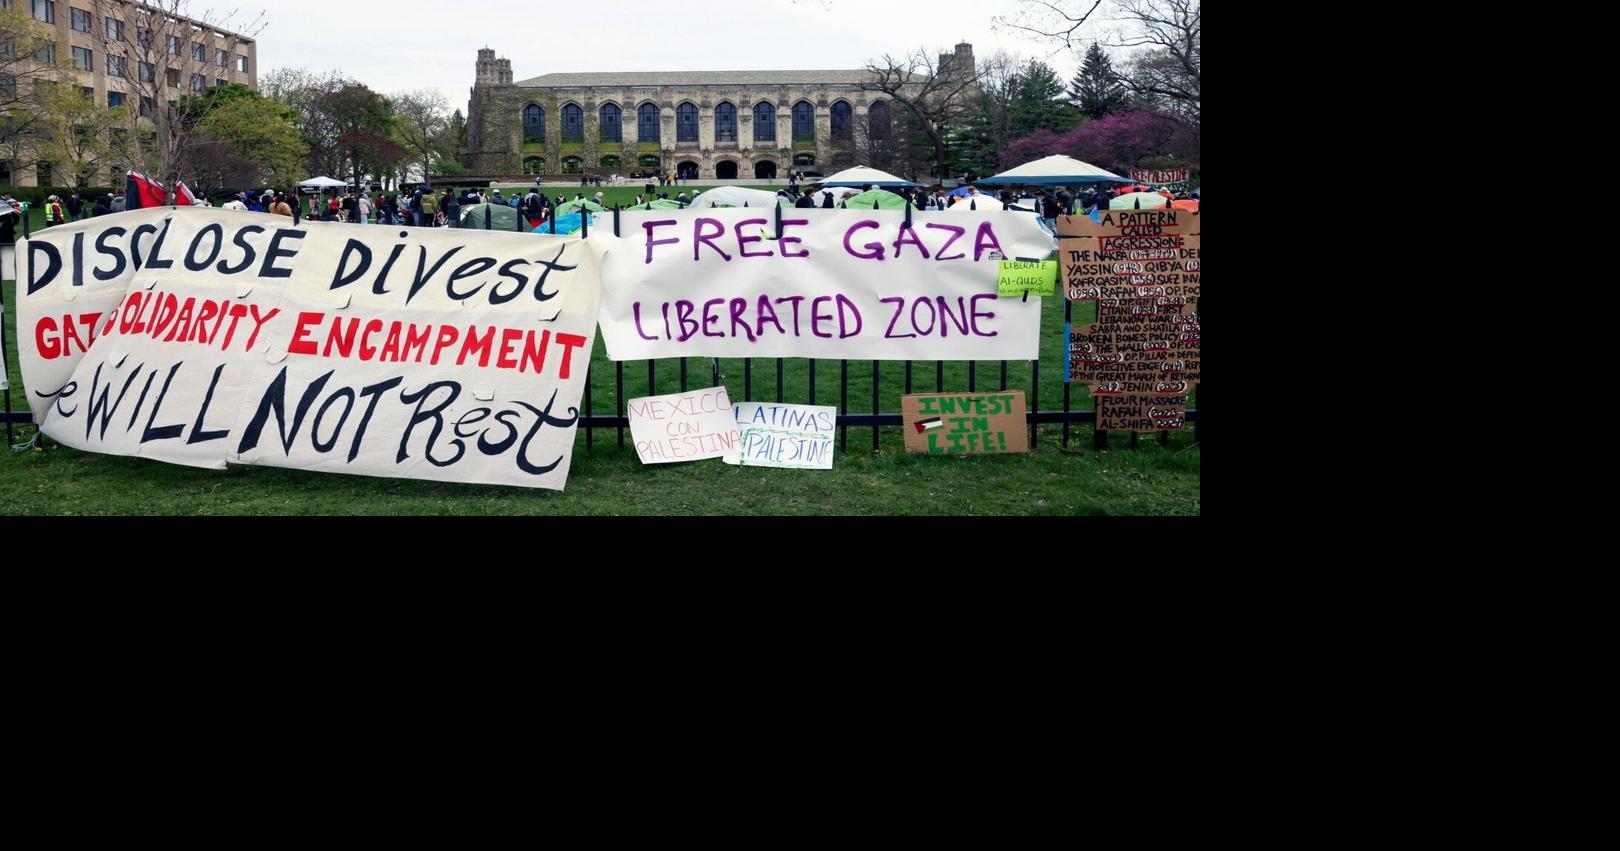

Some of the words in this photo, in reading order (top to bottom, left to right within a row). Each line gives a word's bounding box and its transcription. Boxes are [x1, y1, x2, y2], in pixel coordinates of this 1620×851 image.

[1102, 213, 1115, 226] A
[1120, 211, 1176, 225] PATTERN
[1121, 226, 1162, 236] CALLED
[642, 217, 809, 264] FREE
[842, 219, 1009, 262] GAZA
[26, 217, 306, 295] DISCLOSE
[1069, 250, 1091, 262] THE
[1094, 250, 1128, 261] NAKBA
[1003, 262, 1048, 270] LIBERATE
[1067, 262, 1111, 276] YASSIN
[1145, 260, 1183, 272] QIBYA
[1157, 274, 1180, 285] SUEZ
[1100, 287, 1136, 298] RAFAH
[1157, 305, 1182, 314] FIRST
[632, 293, 862, 343] LIBERATED
[880, 293, 998, 339] ZONE
[1100, 315, 1144, 325] LEBANON
[1149, 315, 1171, 323] WAR
[1090, 324, 1121, 334] SABRA
[1123, 324, 1141, 332] AND
[1143, 324, 1180, 333] SHATILA
[1070, 333, 1113, 343] BROKEN
[1116, 333, 1147, 342] BONES
[1149, 332, 1180, 341] POLICY
[287, 311, 586, 380] ENCAMPMENT
[1095, 344, 1113, 353] THE
[1139, 352, 1168, 361] PILLAR
[1084, 362, 1135, 372] PROTECTIVE
[1137, 361, 1160, 370] EDGE
[1096, 371, 1127, 382] GREAT
[1119, 382, 1153, 392] JENIN
[918, 394, 1015, 416] INVEST
[1102, 395, 1136, 406] FLOUR
[1140, 395, 1186, 406] MASSACRE
[86, 359, 231, 445] WILL
[237, 368, 403, 463] NOT
[628, 391, 733, 422] MEXICO
[1102, 407, 1141, 417] RAFAH
[732, 405, 834, 432] LATINAS
[1100, 418, 1153, 429] AL-SHIFA
[666, 422, 700, 436] CON
[948, 416, 989, 434] IN
[636, 430, 741, 462] PALESTINA
[927, 431, 1007, 454] LIFE!
[747, 432, 833, 466] PALESTINE
